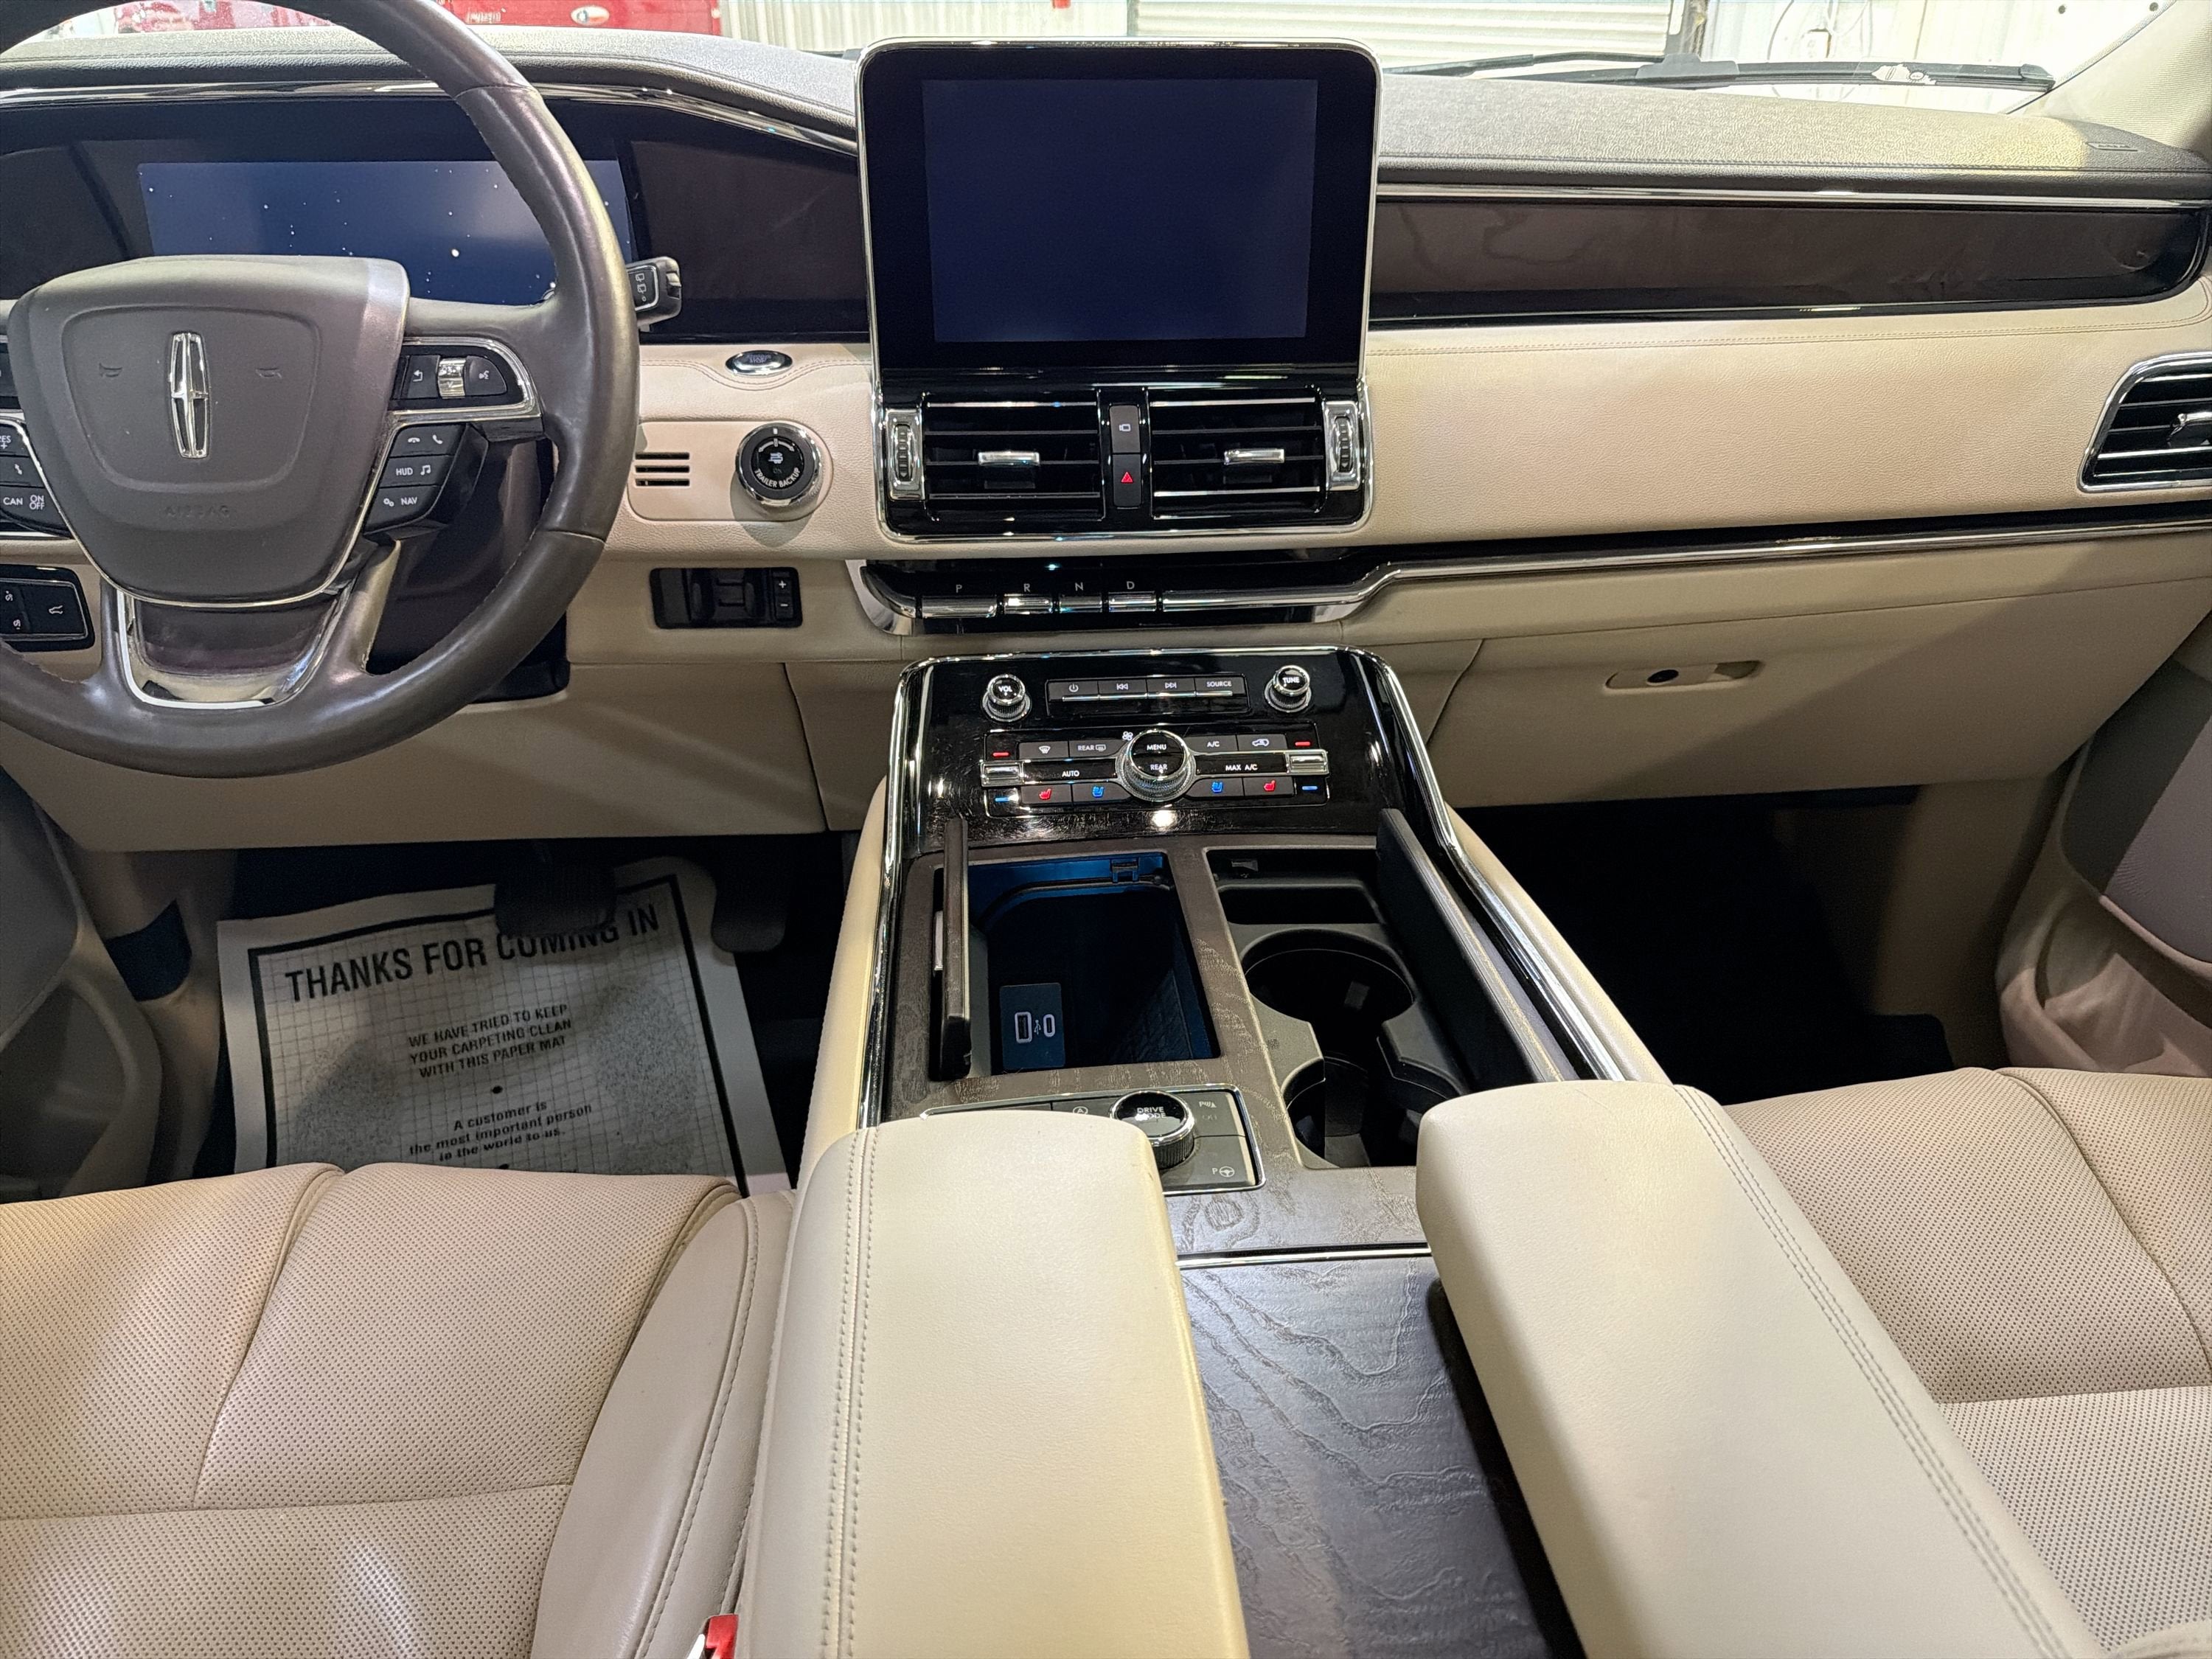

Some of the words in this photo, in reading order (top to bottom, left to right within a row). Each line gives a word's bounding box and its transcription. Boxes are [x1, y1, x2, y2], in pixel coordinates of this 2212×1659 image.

[396, 467, 413, 476] HUD
[754, 468, 778, 487] TRAILER
[779, 467, 801, 487] BACKUP
[3, 497, 23, 505] CAN
[29, 502, 44, 510] OFF
[400, 497, 418, 505] NAV
[956, 584, 962, 593] P
[1023, 583, 1031, 592] R
[1075, 582, 1083, 591] N
[1127, 581, 1135, 590] D
[285, 948, 413, 1001] THANKS
[422, 938, 487, 975] FOR
[628, 904, 659, 936] IN
[408, 1034, 430, 1048] WE
[434, 1026, 468, 1043] HAVE
[472, 1014, 509, 1032] TRIED
[514, 1010, 531, 1023] TO
[535, 1004, 567, 1020] KEEP
[410, 1047, 448, 1065] YOUR
[452, 1027, 526, 1056] CARPETING
[419, 1061, 454, 1078] WITH
[459, 1053, 489, 1070] THIS
[493, 1042, 535, 1062] PAPER
[540, 1035, 566, 1051] MAT
[454, 1120, 463, 1131] A
[467, 1105, 532, 1128] customer
[536, 1101, 547, 1112] is
[409, 1144, 431, 1156] the
[437, 1133, 470, 1150] most
[476, 1117, 542, 1141] important
[546, 1105, 592, 1126] person
[457, 1147, 479, 1158] the
[484, 1135, 523, 1151] world
[526, 1133, 540, 1142] to
